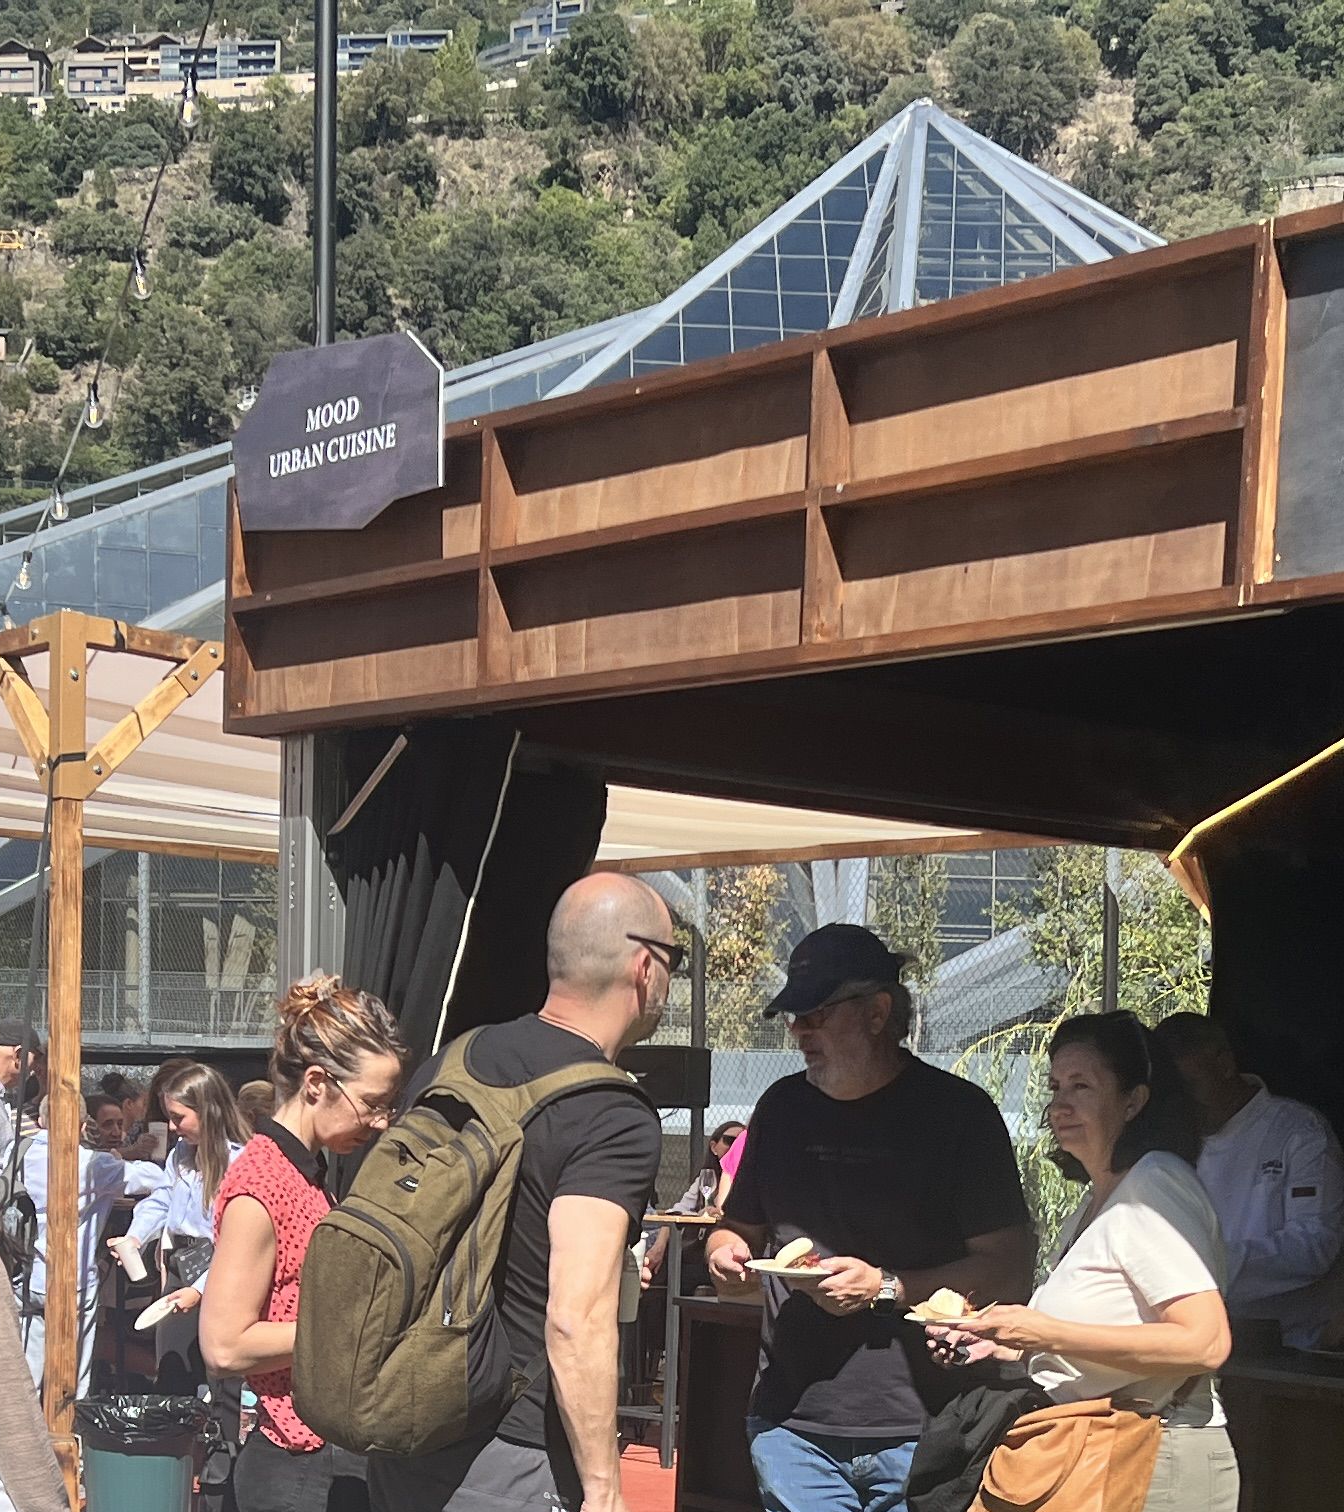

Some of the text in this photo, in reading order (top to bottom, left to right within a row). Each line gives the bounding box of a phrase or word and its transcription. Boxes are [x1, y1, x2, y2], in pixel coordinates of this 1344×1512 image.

[305, 395, 360, 433] MOOD
[269, 422, 397, 478] URBAN CUISINE
